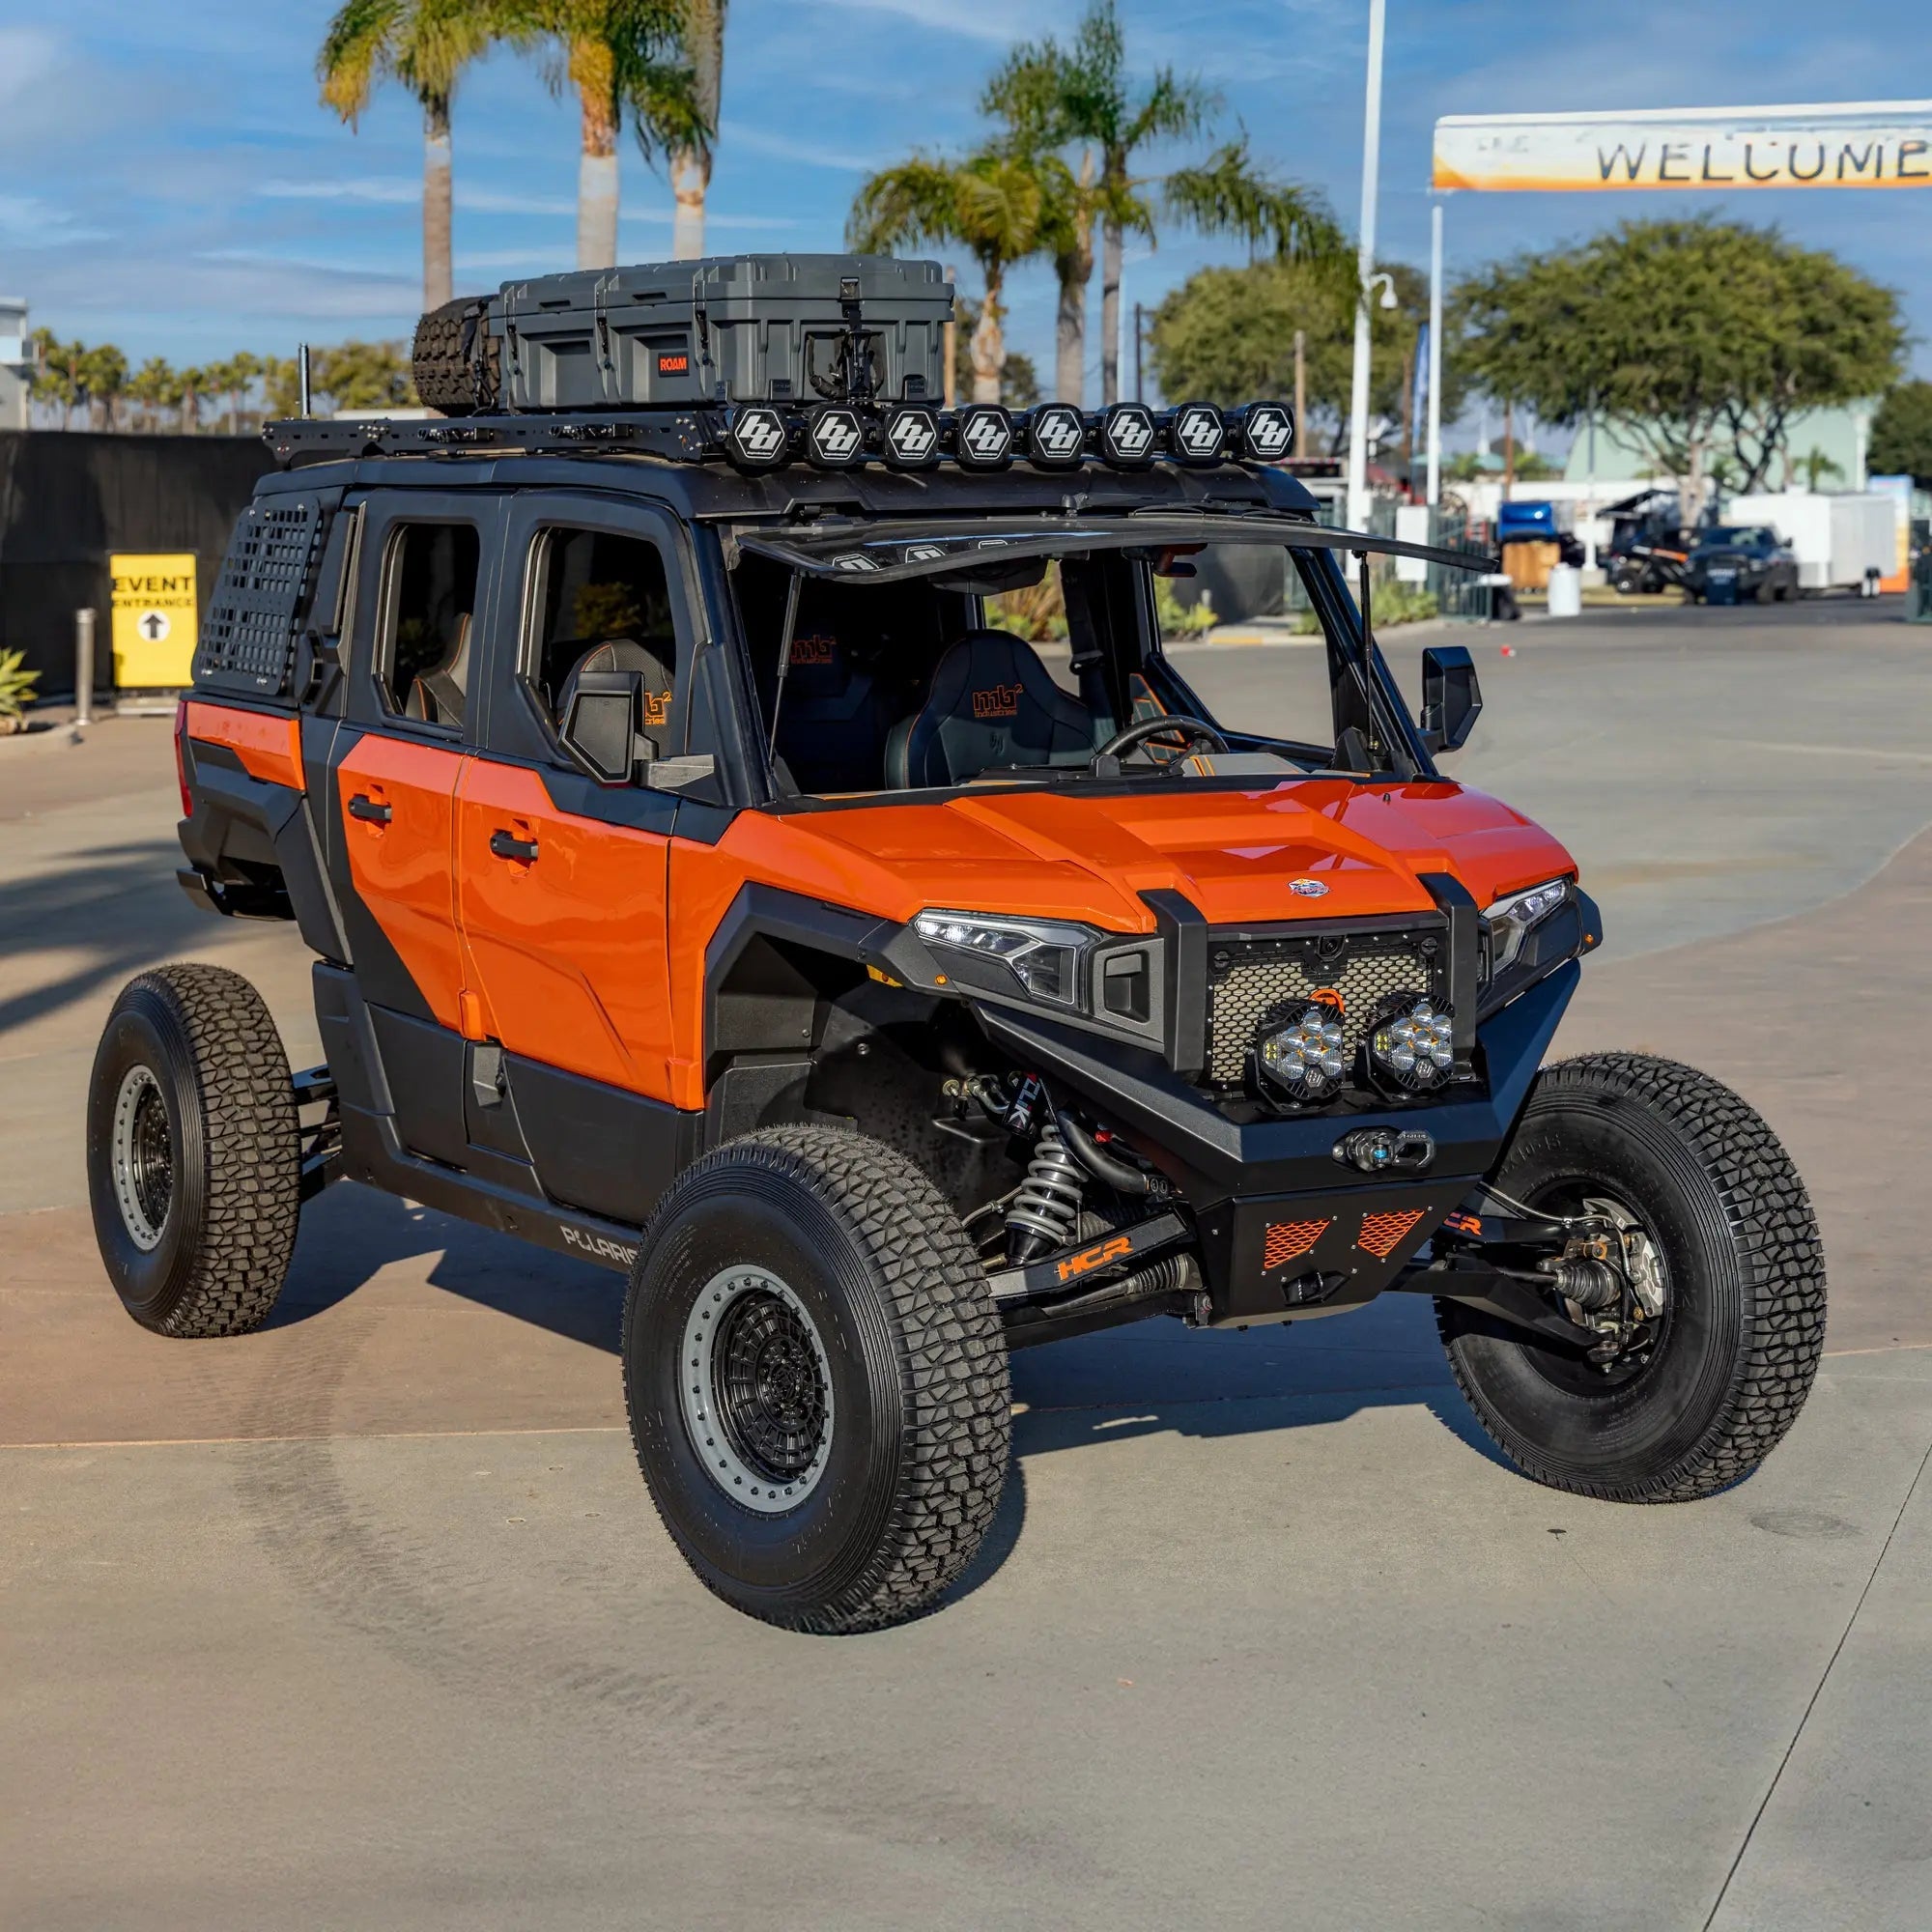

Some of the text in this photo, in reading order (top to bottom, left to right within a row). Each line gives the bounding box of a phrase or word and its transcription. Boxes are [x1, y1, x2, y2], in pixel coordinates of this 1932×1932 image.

[660, 356, 687, 371] ROAM
[113, 577, 192, 592] EVENT
[112, 597, 194, 609] ENTRANCE
[1443, 1211, 1482, 1236] CR
[1058, 1236, 1134, 1281] HCR
